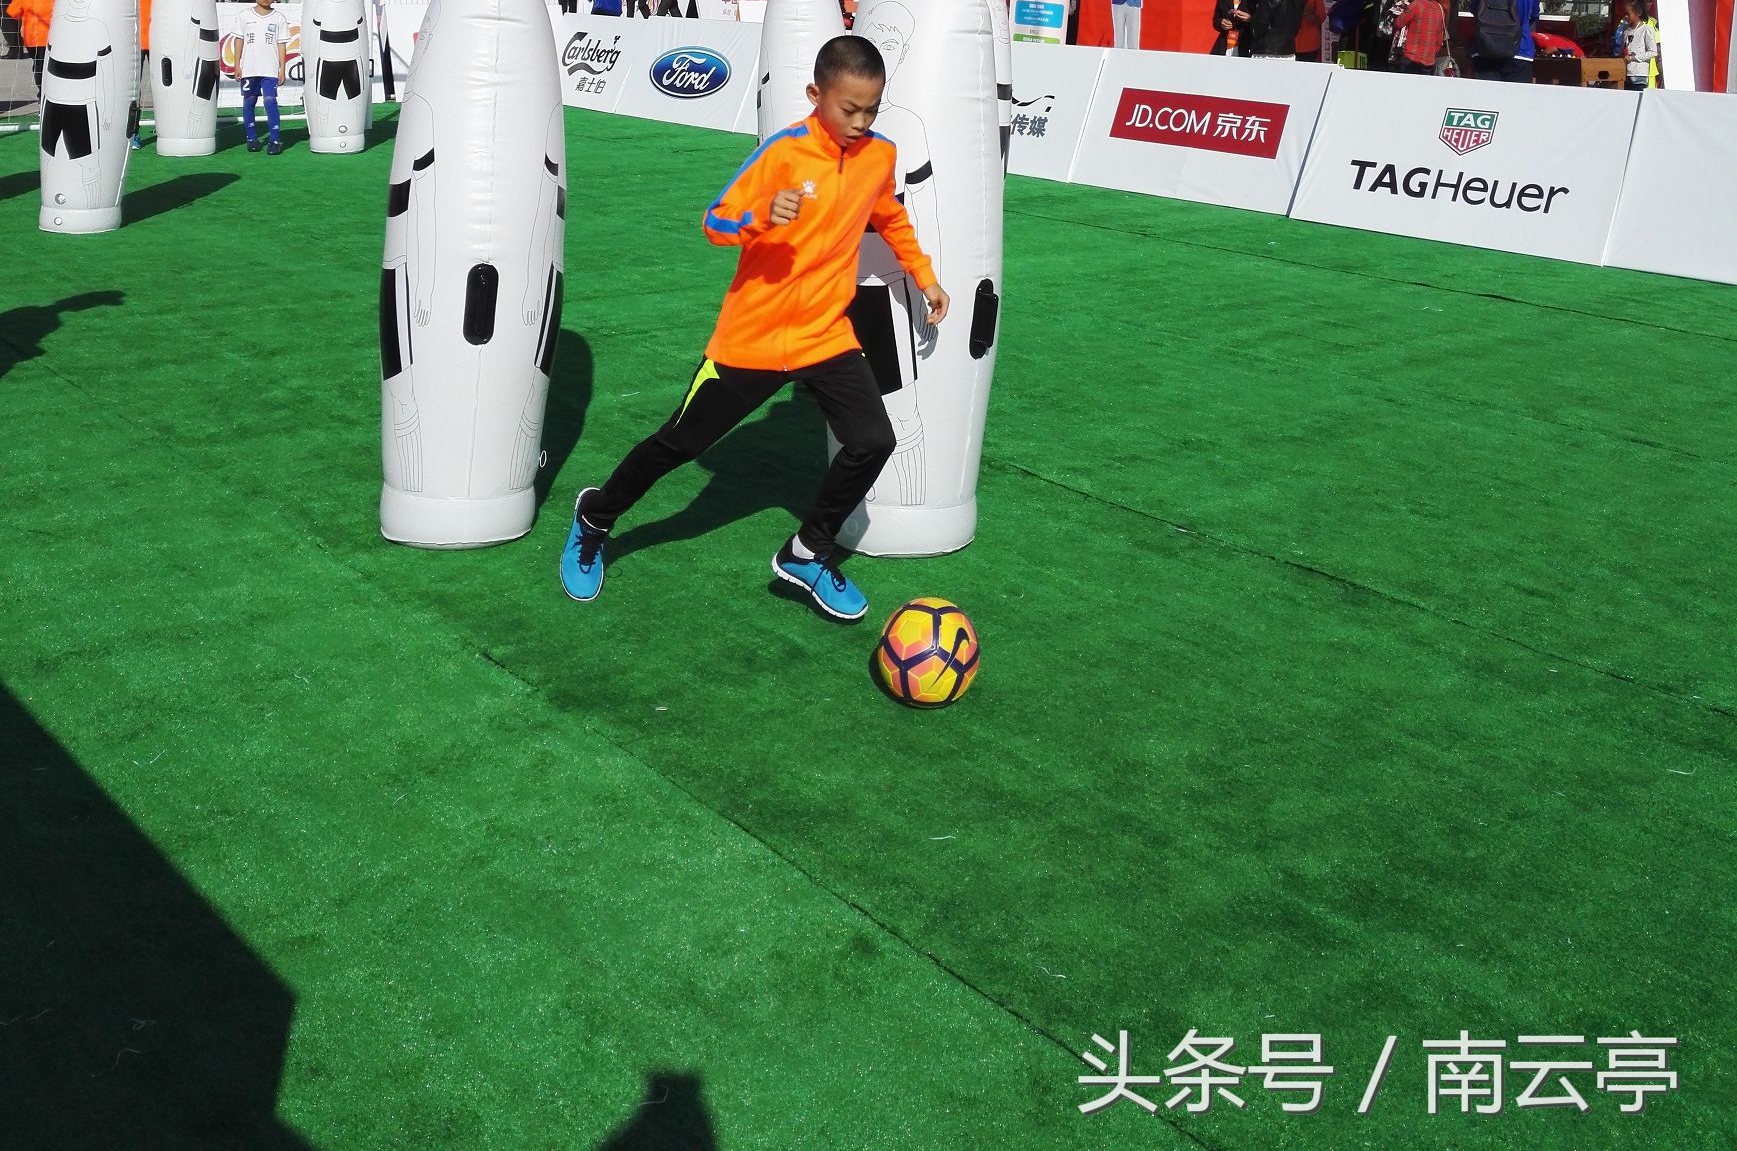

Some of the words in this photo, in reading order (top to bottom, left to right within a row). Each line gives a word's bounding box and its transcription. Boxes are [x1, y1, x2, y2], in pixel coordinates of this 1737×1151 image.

[562, 32, 621, 72] Carlsberg
[574, 76, 607, 94] 嘉士伯
[662, 54, 717, 91] Ford
[1010, 113, 1049, 138] 传媒
[1125, 103, 1212, 136] JD.COM
[1213, 112, 1272, 144] 京东
[1450, 112, 1492, 129] TAG
[1442, 128, 1490, 151] HEUER
